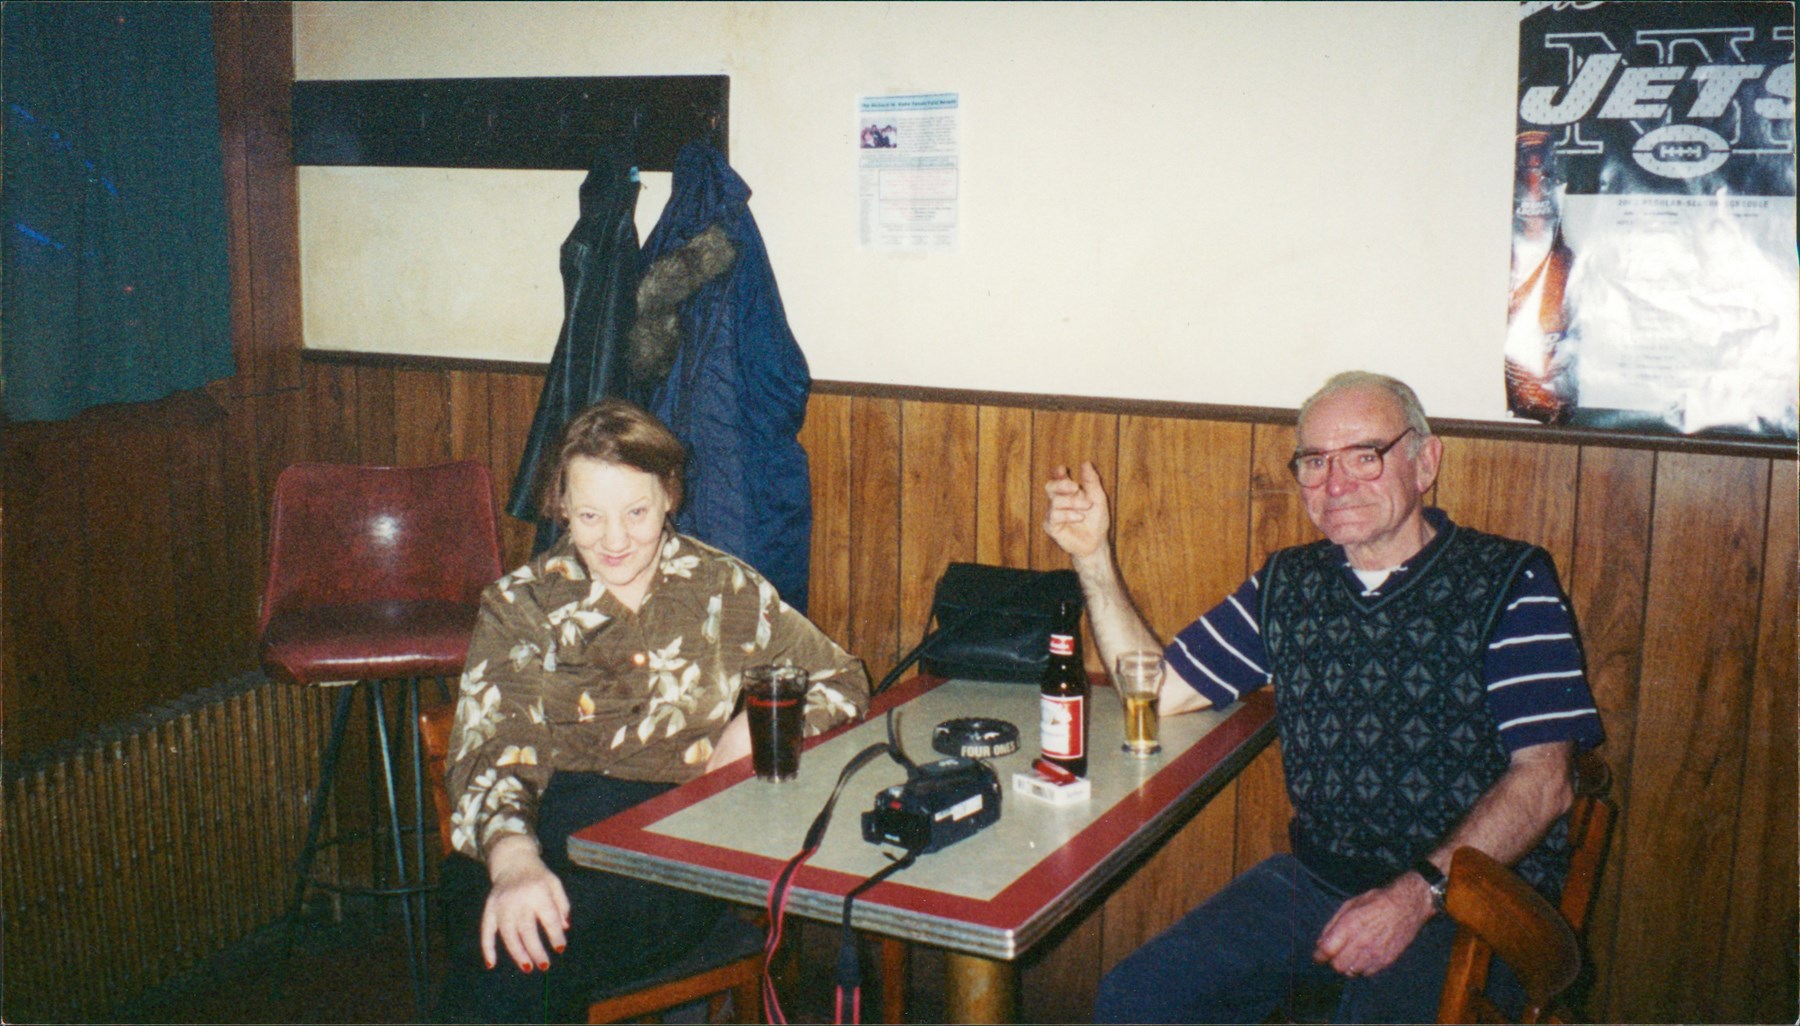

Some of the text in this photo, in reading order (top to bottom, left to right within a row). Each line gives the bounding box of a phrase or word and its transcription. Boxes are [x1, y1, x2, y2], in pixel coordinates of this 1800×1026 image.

[1519, 53, 1795, 126] JETS
[1642, 199, 1718, 208] REGULAR-SEAON
[1724, 200, 1769, 208] CHEDULE
[961, 740, 1016, 758] FOUR ONES
